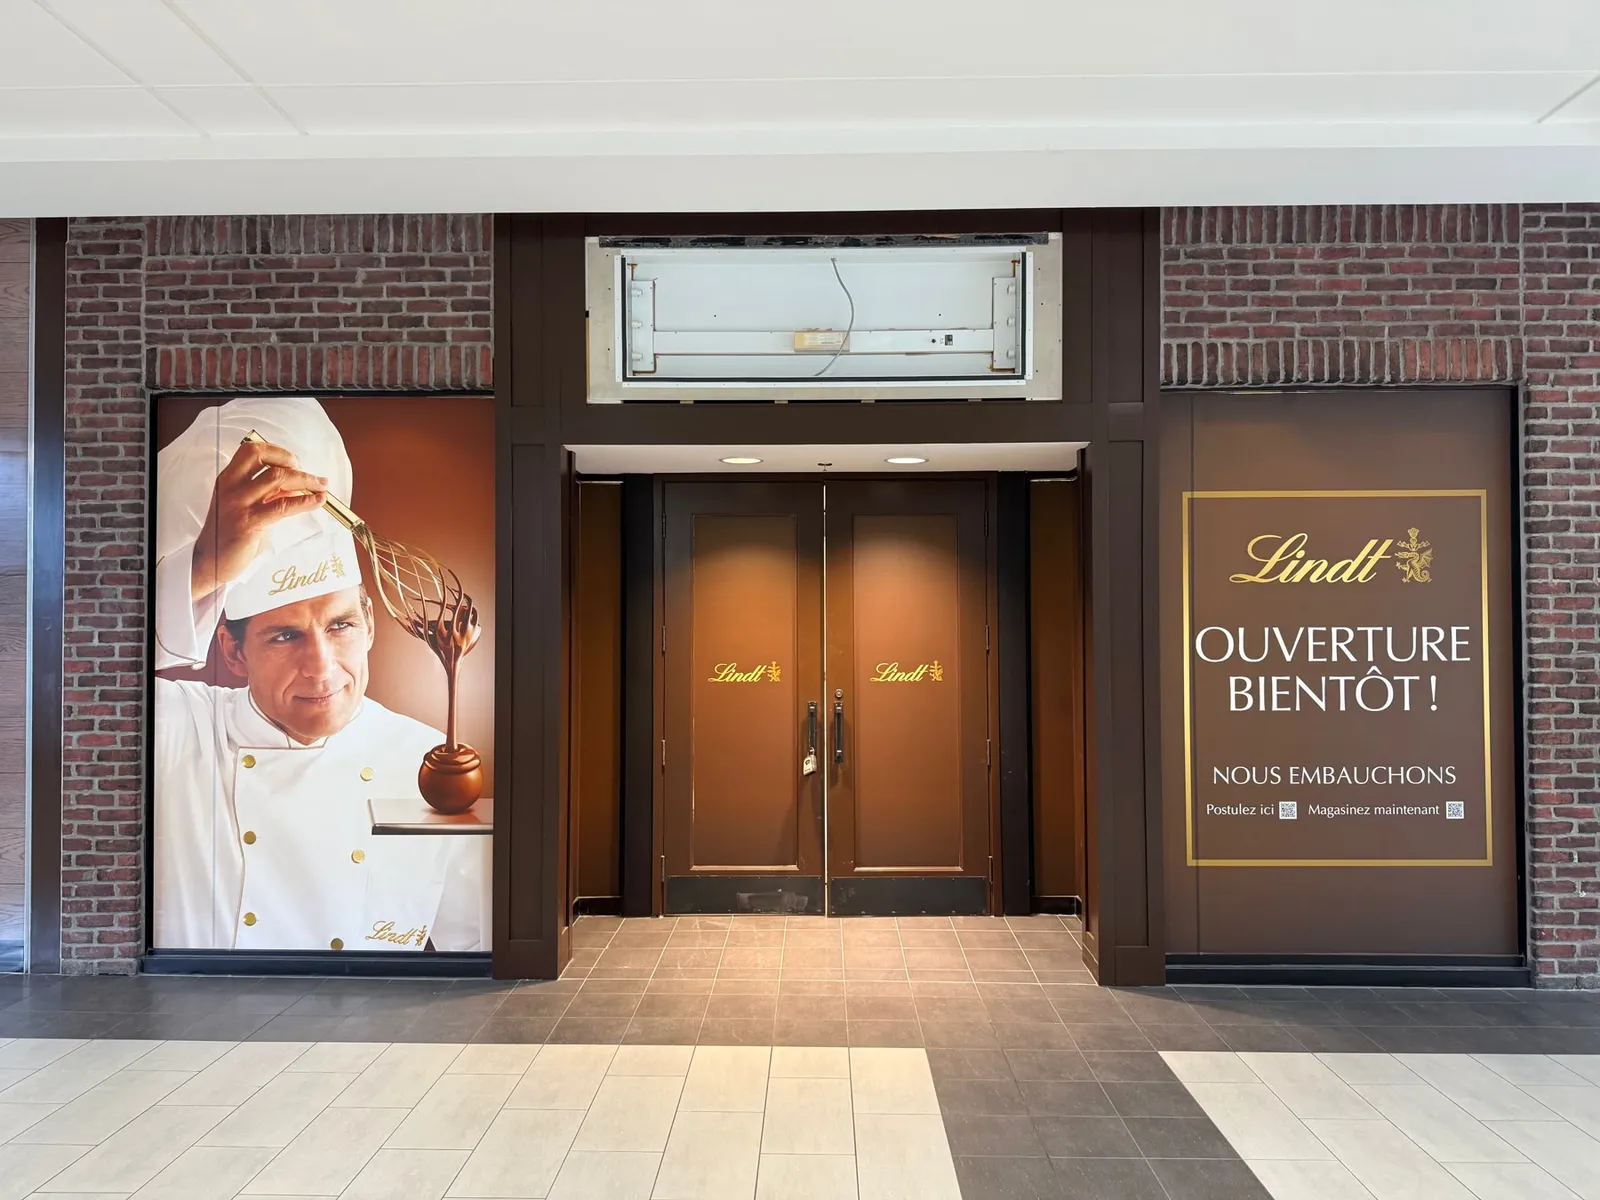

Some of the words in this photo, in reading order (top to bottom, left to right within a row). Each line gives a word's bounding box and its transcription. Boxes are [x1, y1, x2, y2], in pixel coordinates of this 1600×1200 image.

[1228, 533, 1394, 584] Lindt
[268, 562, 330, 596] Lindt
[1195, 625, 1471, 663] OUVERTURE
[708, 662, 767, 683] Lindt
[870, 662, 930, 683] Lindt
[1228, 665, 1420, 712] BIENTÔT
[1213, 765, 1281, 785] NOUS
[1289, 765, 1457, 785] EMBAUCHONS
[1206, 803, 1257, 816] Postulez
[1260, 803, 1275, 816] ici
[1308, 803, 1371, 818] Magasinez
[1374, 803, 1440, 816] maintenant
[365, 920, 416, 946] Lindt
